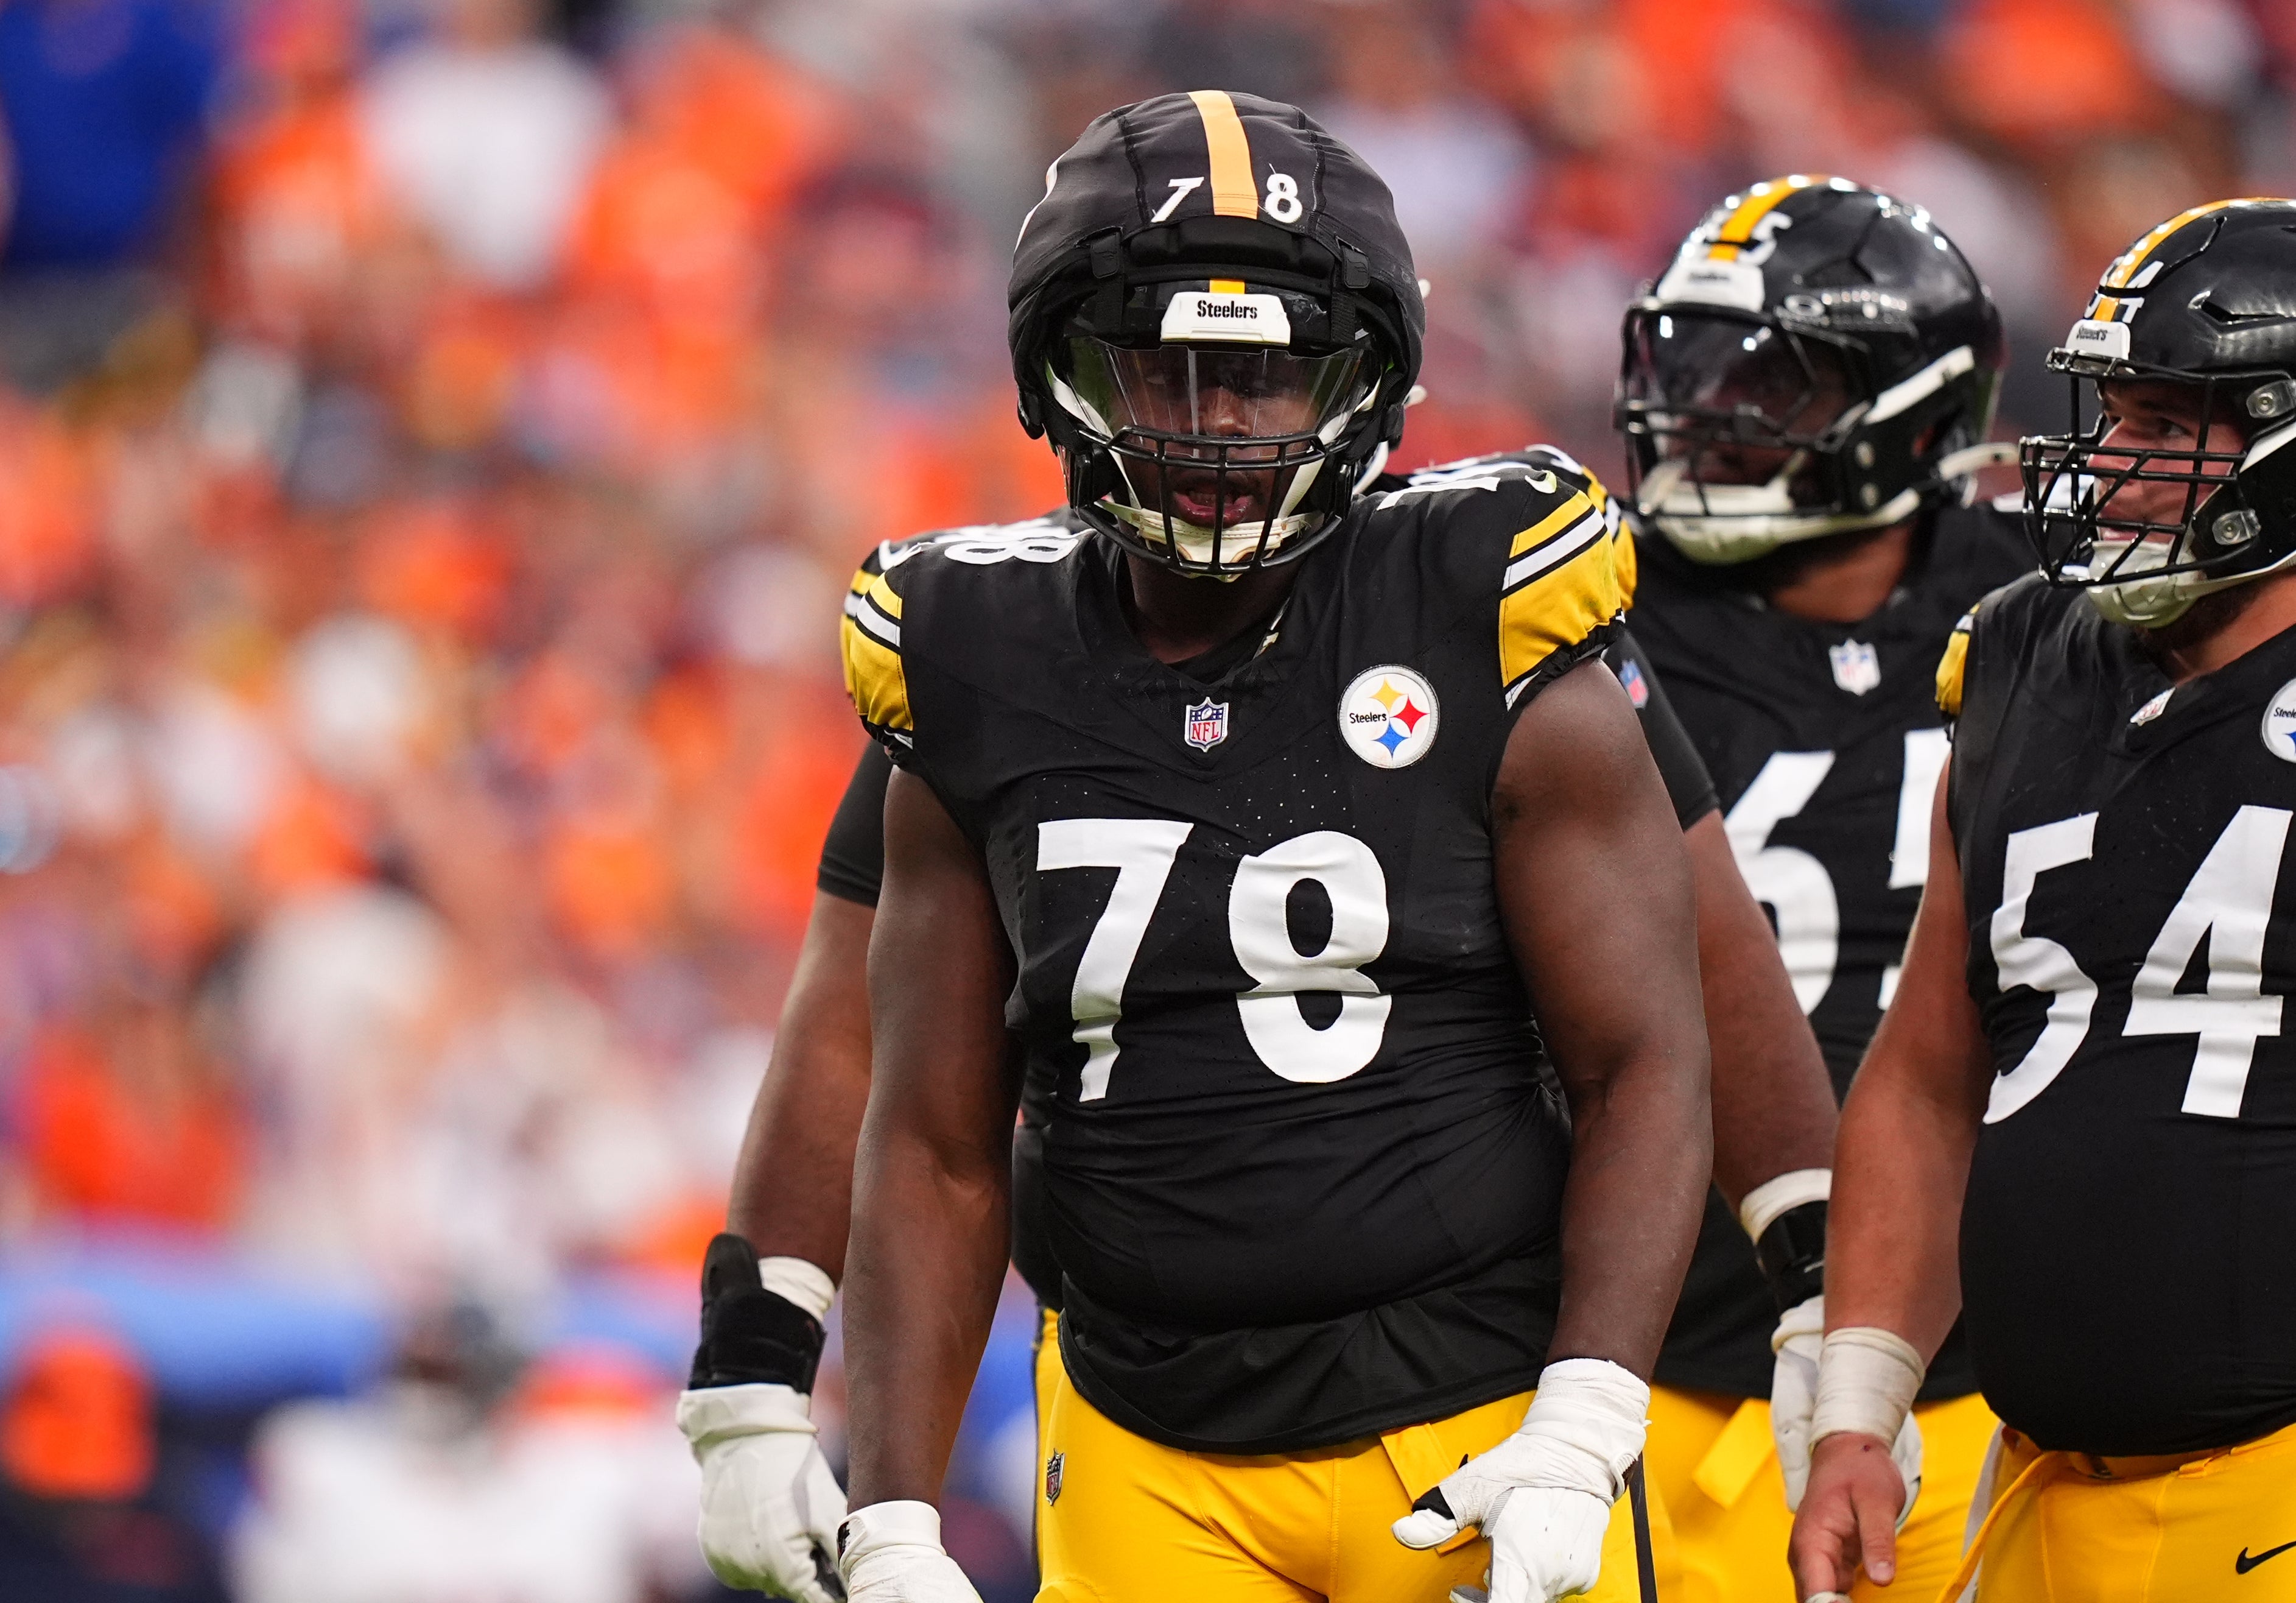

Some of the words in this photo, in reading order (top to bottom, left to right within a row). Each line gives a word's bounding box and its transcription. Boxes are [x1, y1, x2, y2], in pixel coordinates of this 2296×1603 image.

[1151, 174, 1303, 223] 78
[1196, 300, 1258, 320] Steelers
[1192, 722, 1219, 742] NFL
[1349, 711, 1387, 724] Steelers
[1036, 819, 1392, 1102] 78
[1983, 805, 2294, 1124] 54
